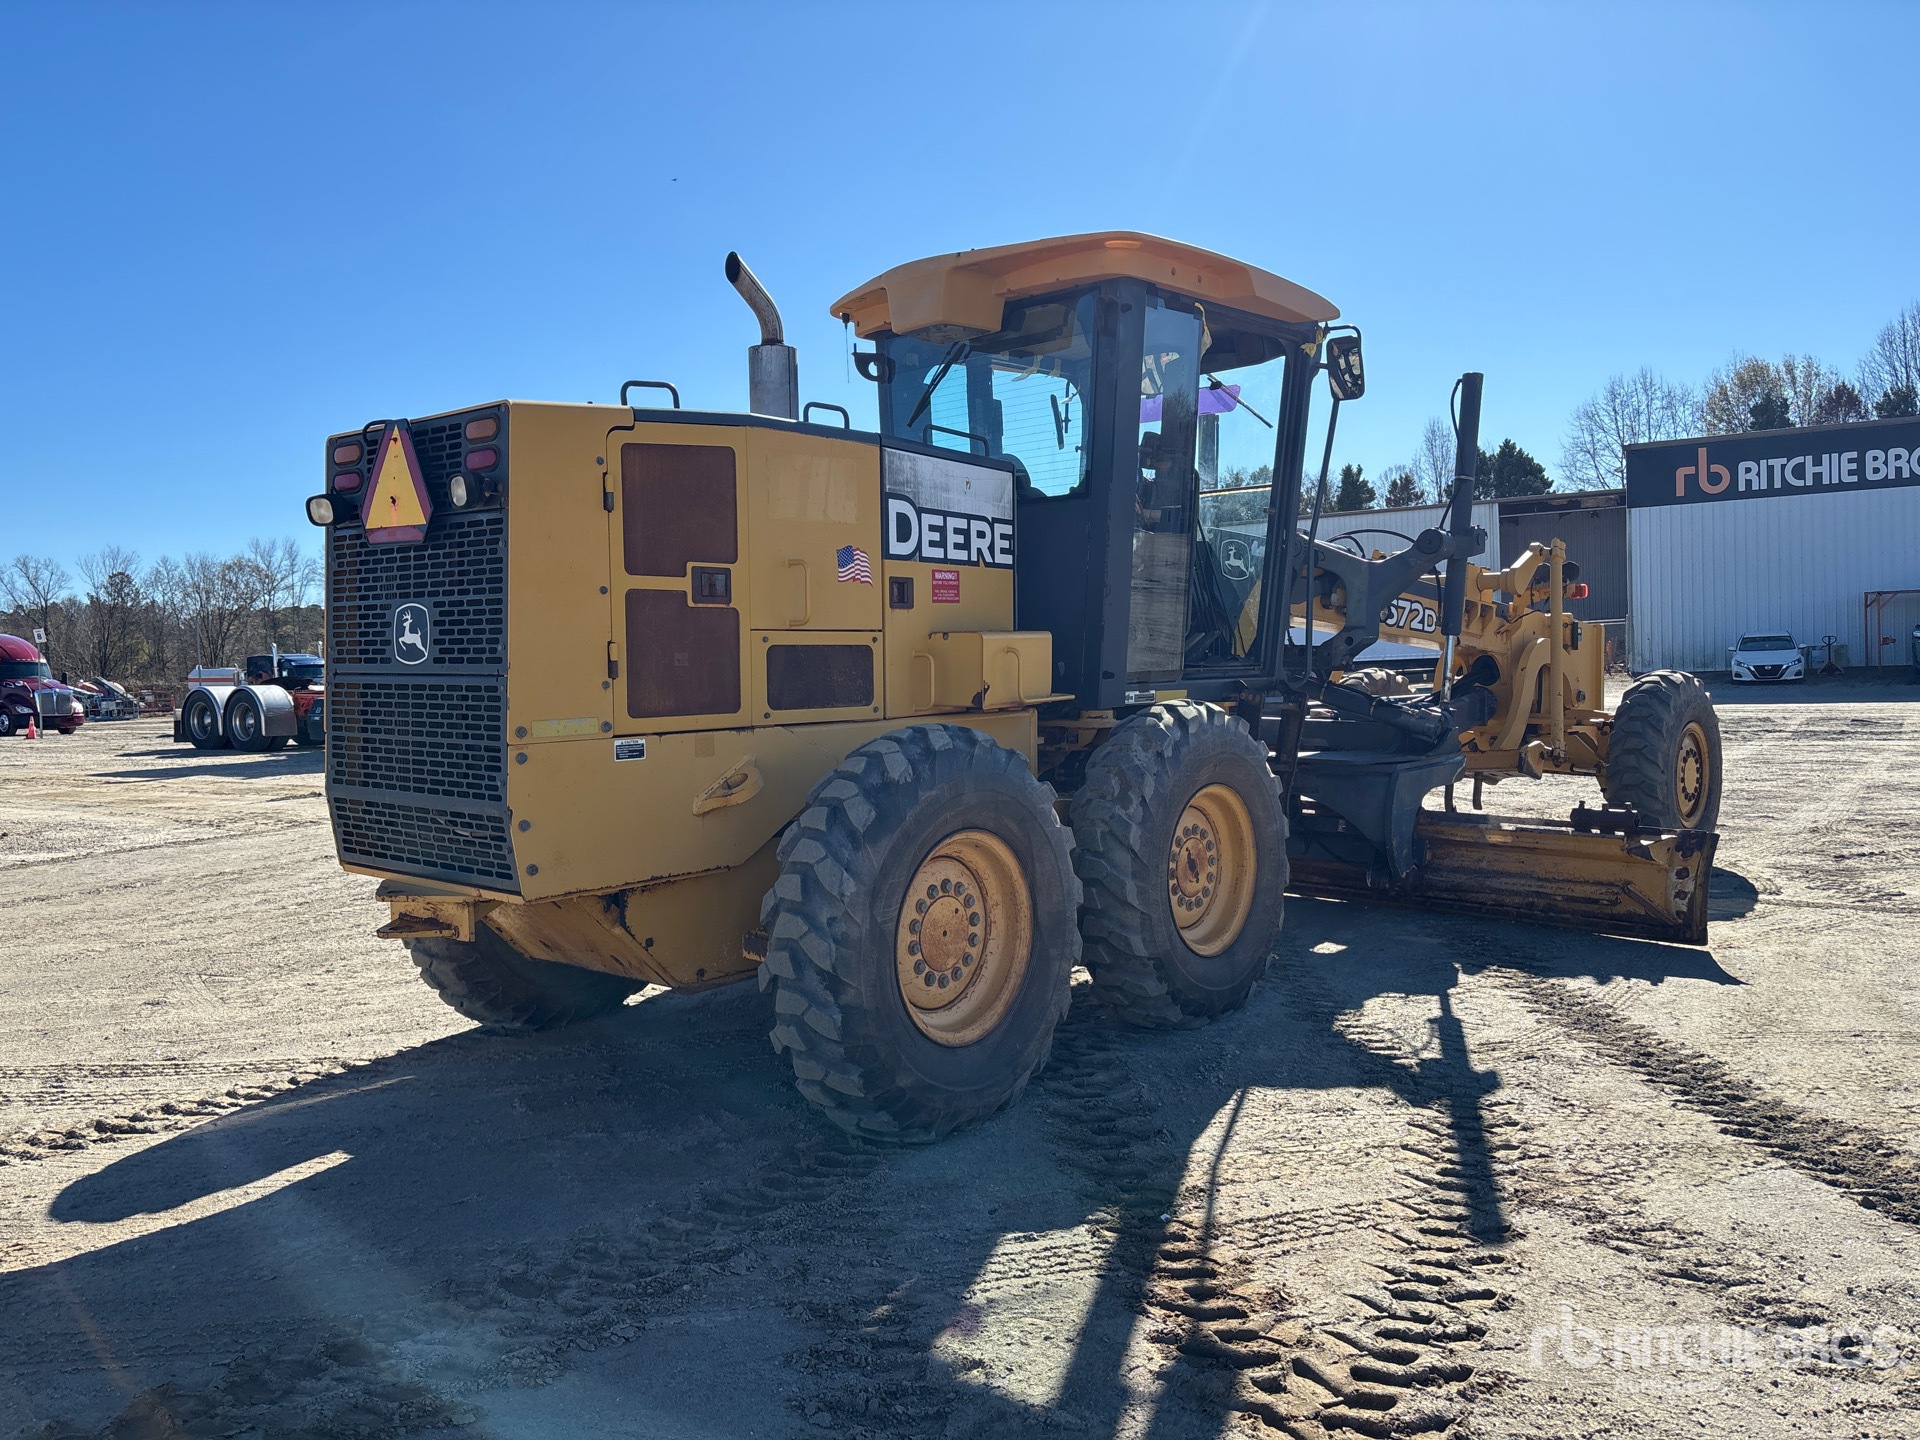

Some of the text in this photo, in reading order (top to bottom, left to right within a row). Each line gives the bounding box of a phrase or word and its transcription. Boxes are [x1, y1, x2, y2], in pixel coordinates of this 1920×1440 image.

[1676, 447, 1731, 497] rb
[1738, 451, 1858, 492] RITCHIE
[888, 498, 1013, 565] DEERE
